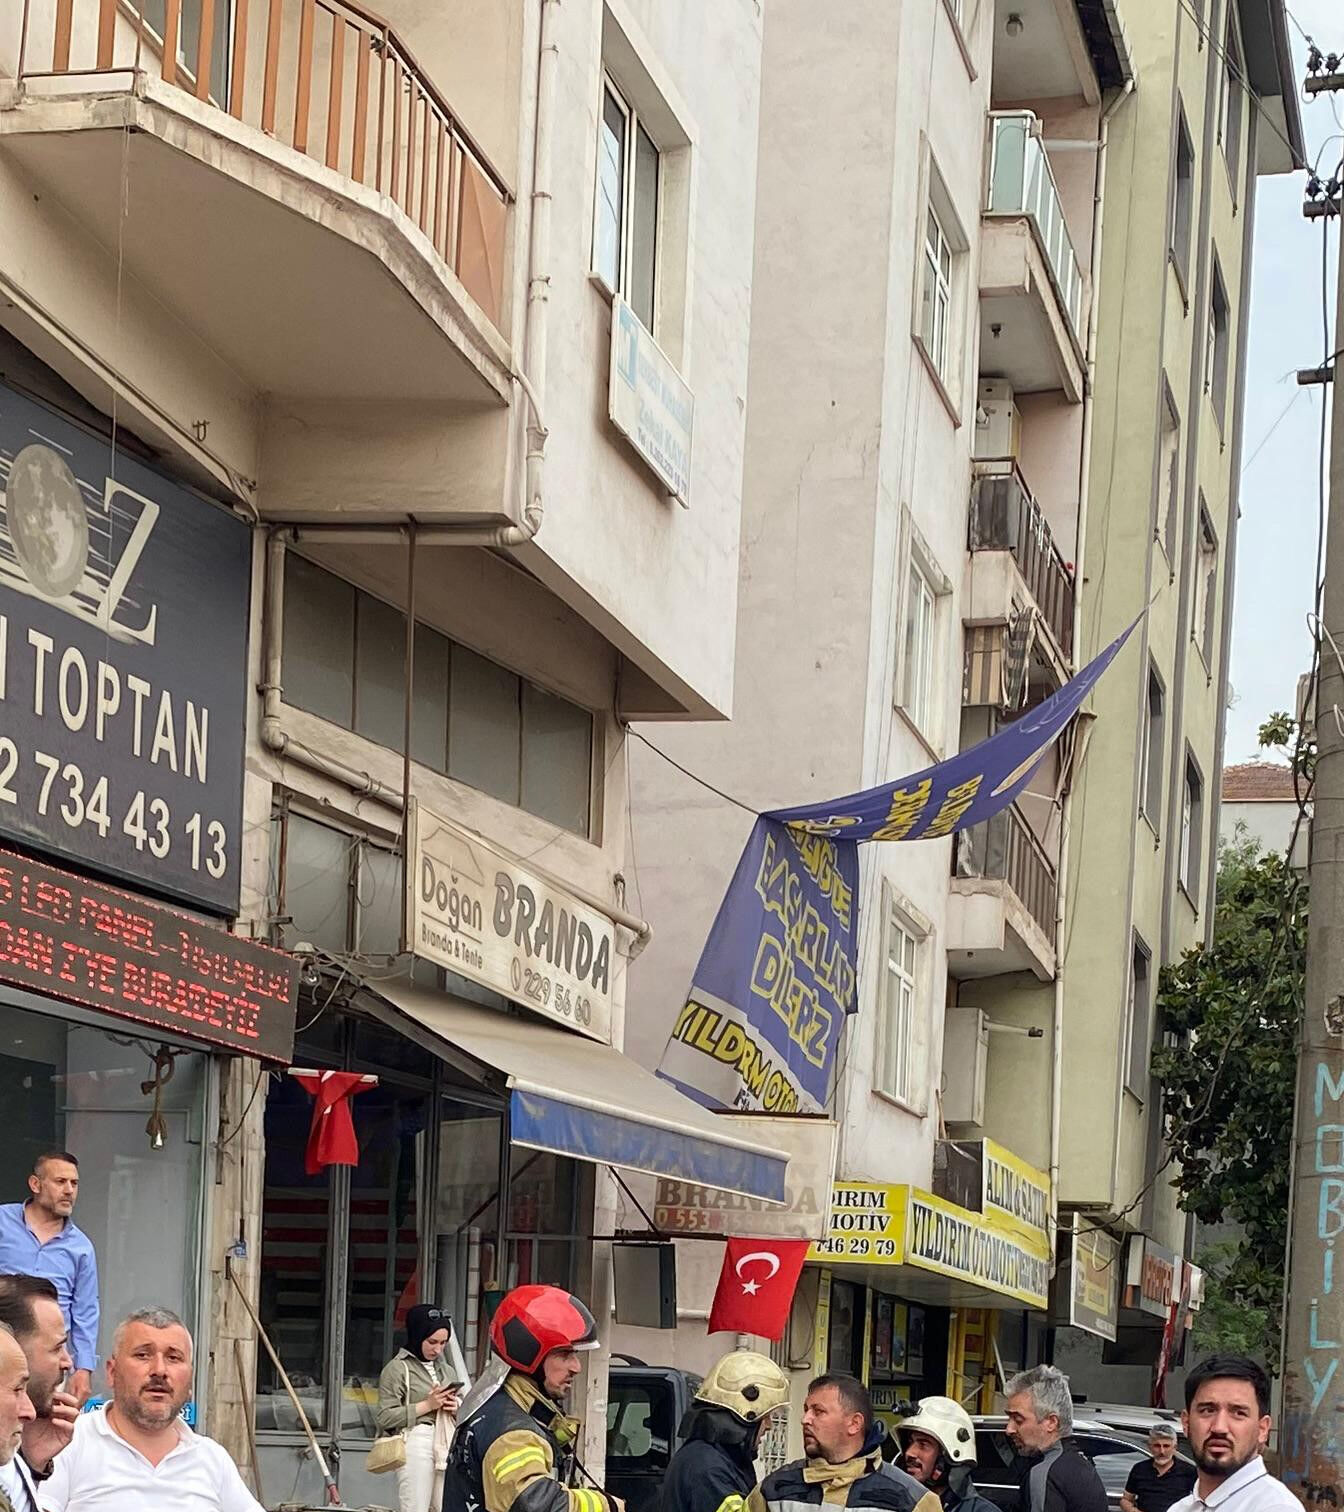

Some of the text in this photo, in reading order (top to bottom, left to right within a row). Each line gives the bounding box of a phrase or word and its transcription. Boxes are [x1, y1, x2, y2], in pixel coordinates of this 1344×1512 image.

[28, 628, 209, 784] TOPTAN
[34, 747, 109, 838] 734
[122, 787, 170, 859] 43
[185, 811, 228, 880] 13
[421, 855, 483, 934] Doğan
[492, 871, 611, 996] BRANDA
[421, 922, 453, 956] Branda
[832, 1190, 886, 1208] IRIM
[850, 1239, 869, 1254] 29
[876, 1240, 894, 1255] 79
